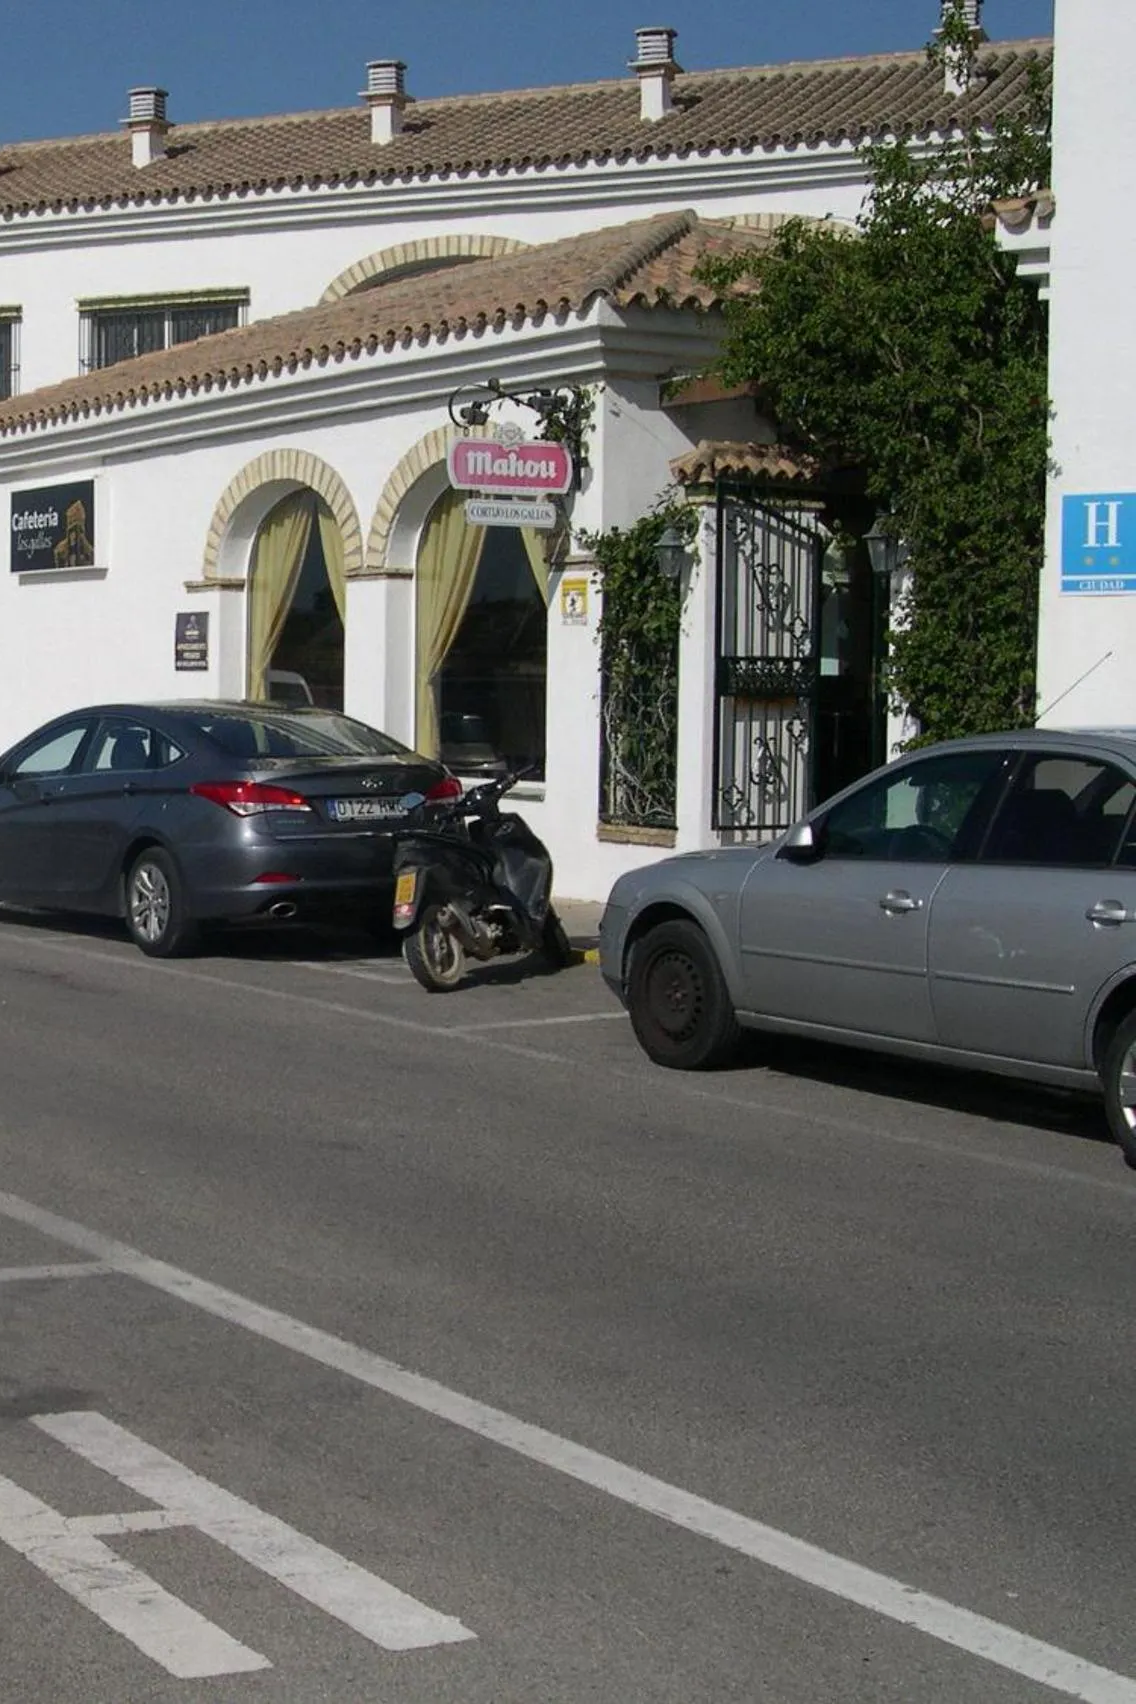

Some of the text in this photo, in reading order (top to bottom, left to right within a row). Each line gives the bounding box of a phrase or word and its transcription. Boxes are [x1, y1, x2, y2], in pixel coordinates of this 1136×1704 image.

[466, 451, 557, 478] Mahou
[12, 506, 59, 531] Cafetería
[1082, 501, 1123, 548] H
